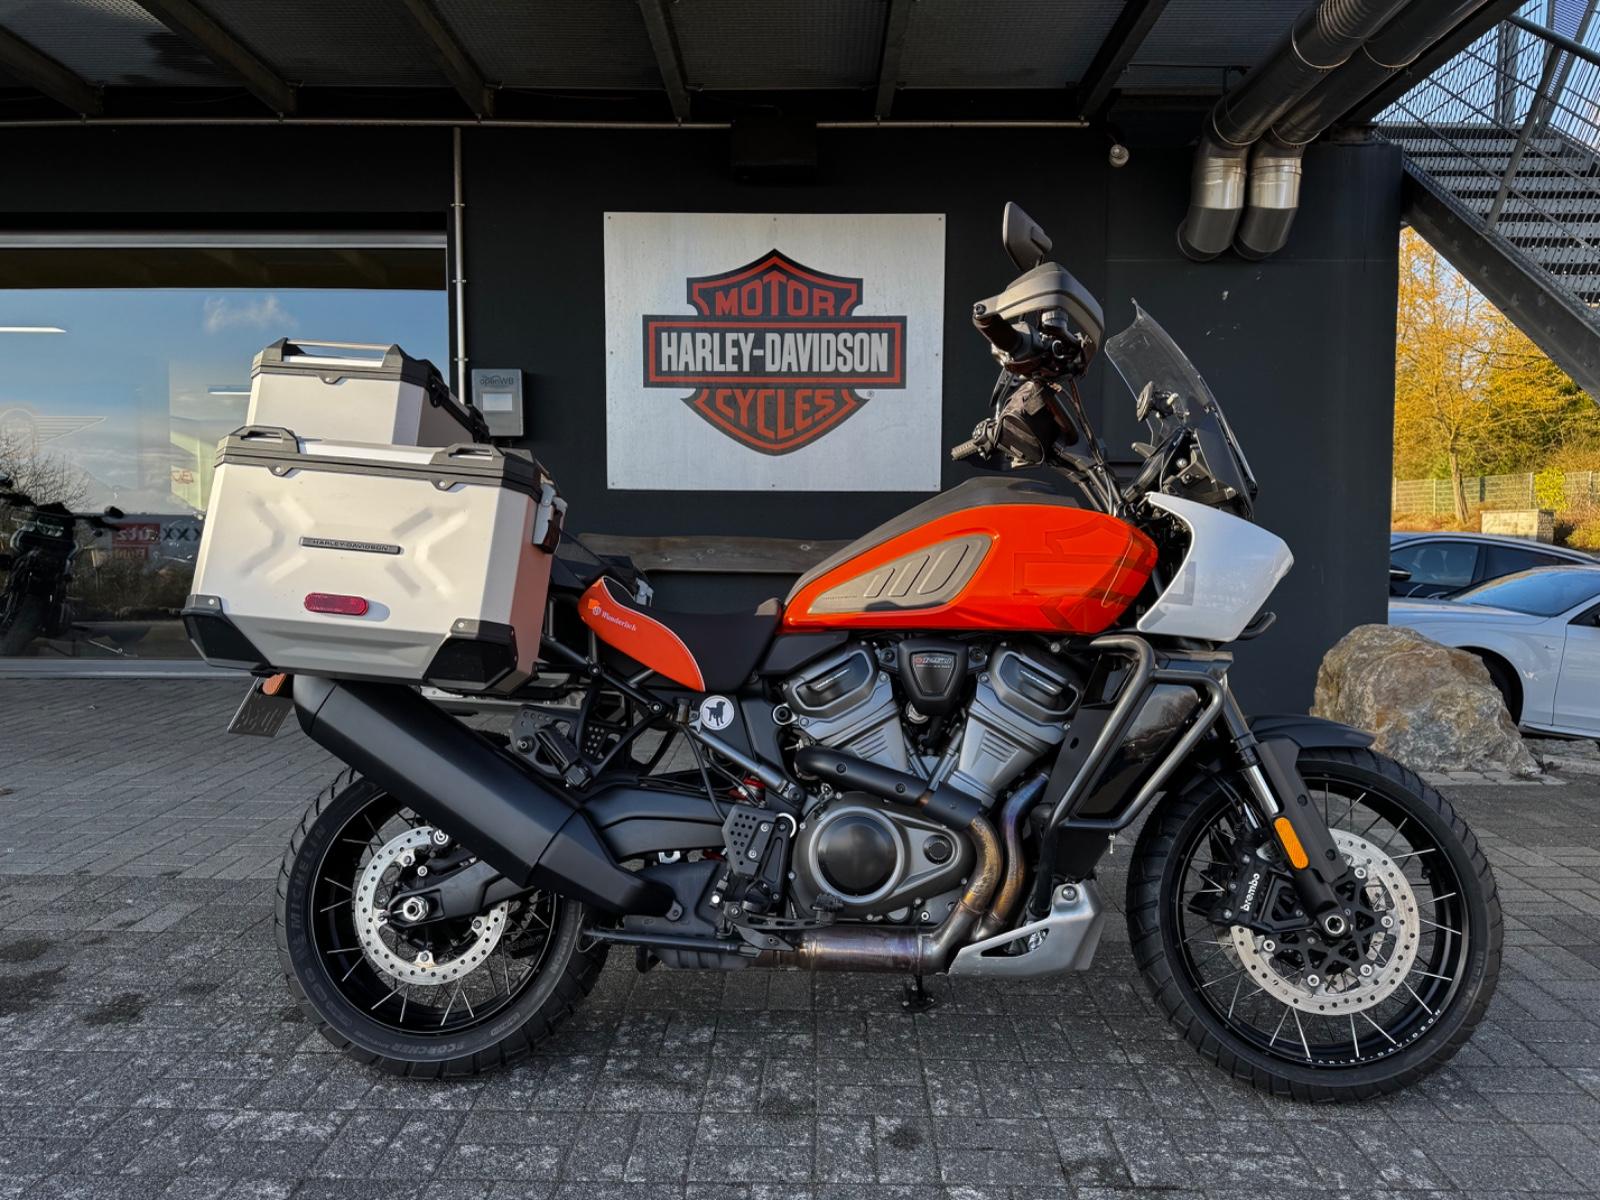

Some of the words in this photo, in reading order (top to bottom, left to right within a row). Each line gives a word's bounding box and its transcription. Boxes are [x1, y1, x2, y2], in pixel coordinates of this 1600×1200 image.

[715, 269, 836, 317] MOTOR
[660, 331, 889, 373] HARLEY-DAVIDSON
[715, 388, 838, 441] CYCLES
[312, 538, 390, 552] HARLEY-DAVIDSON
[601, 611, 637, 632] Wunderlich
[290, 824, 327, 930] MICHELIN
[1240, 872, 1260, 912] brembo
